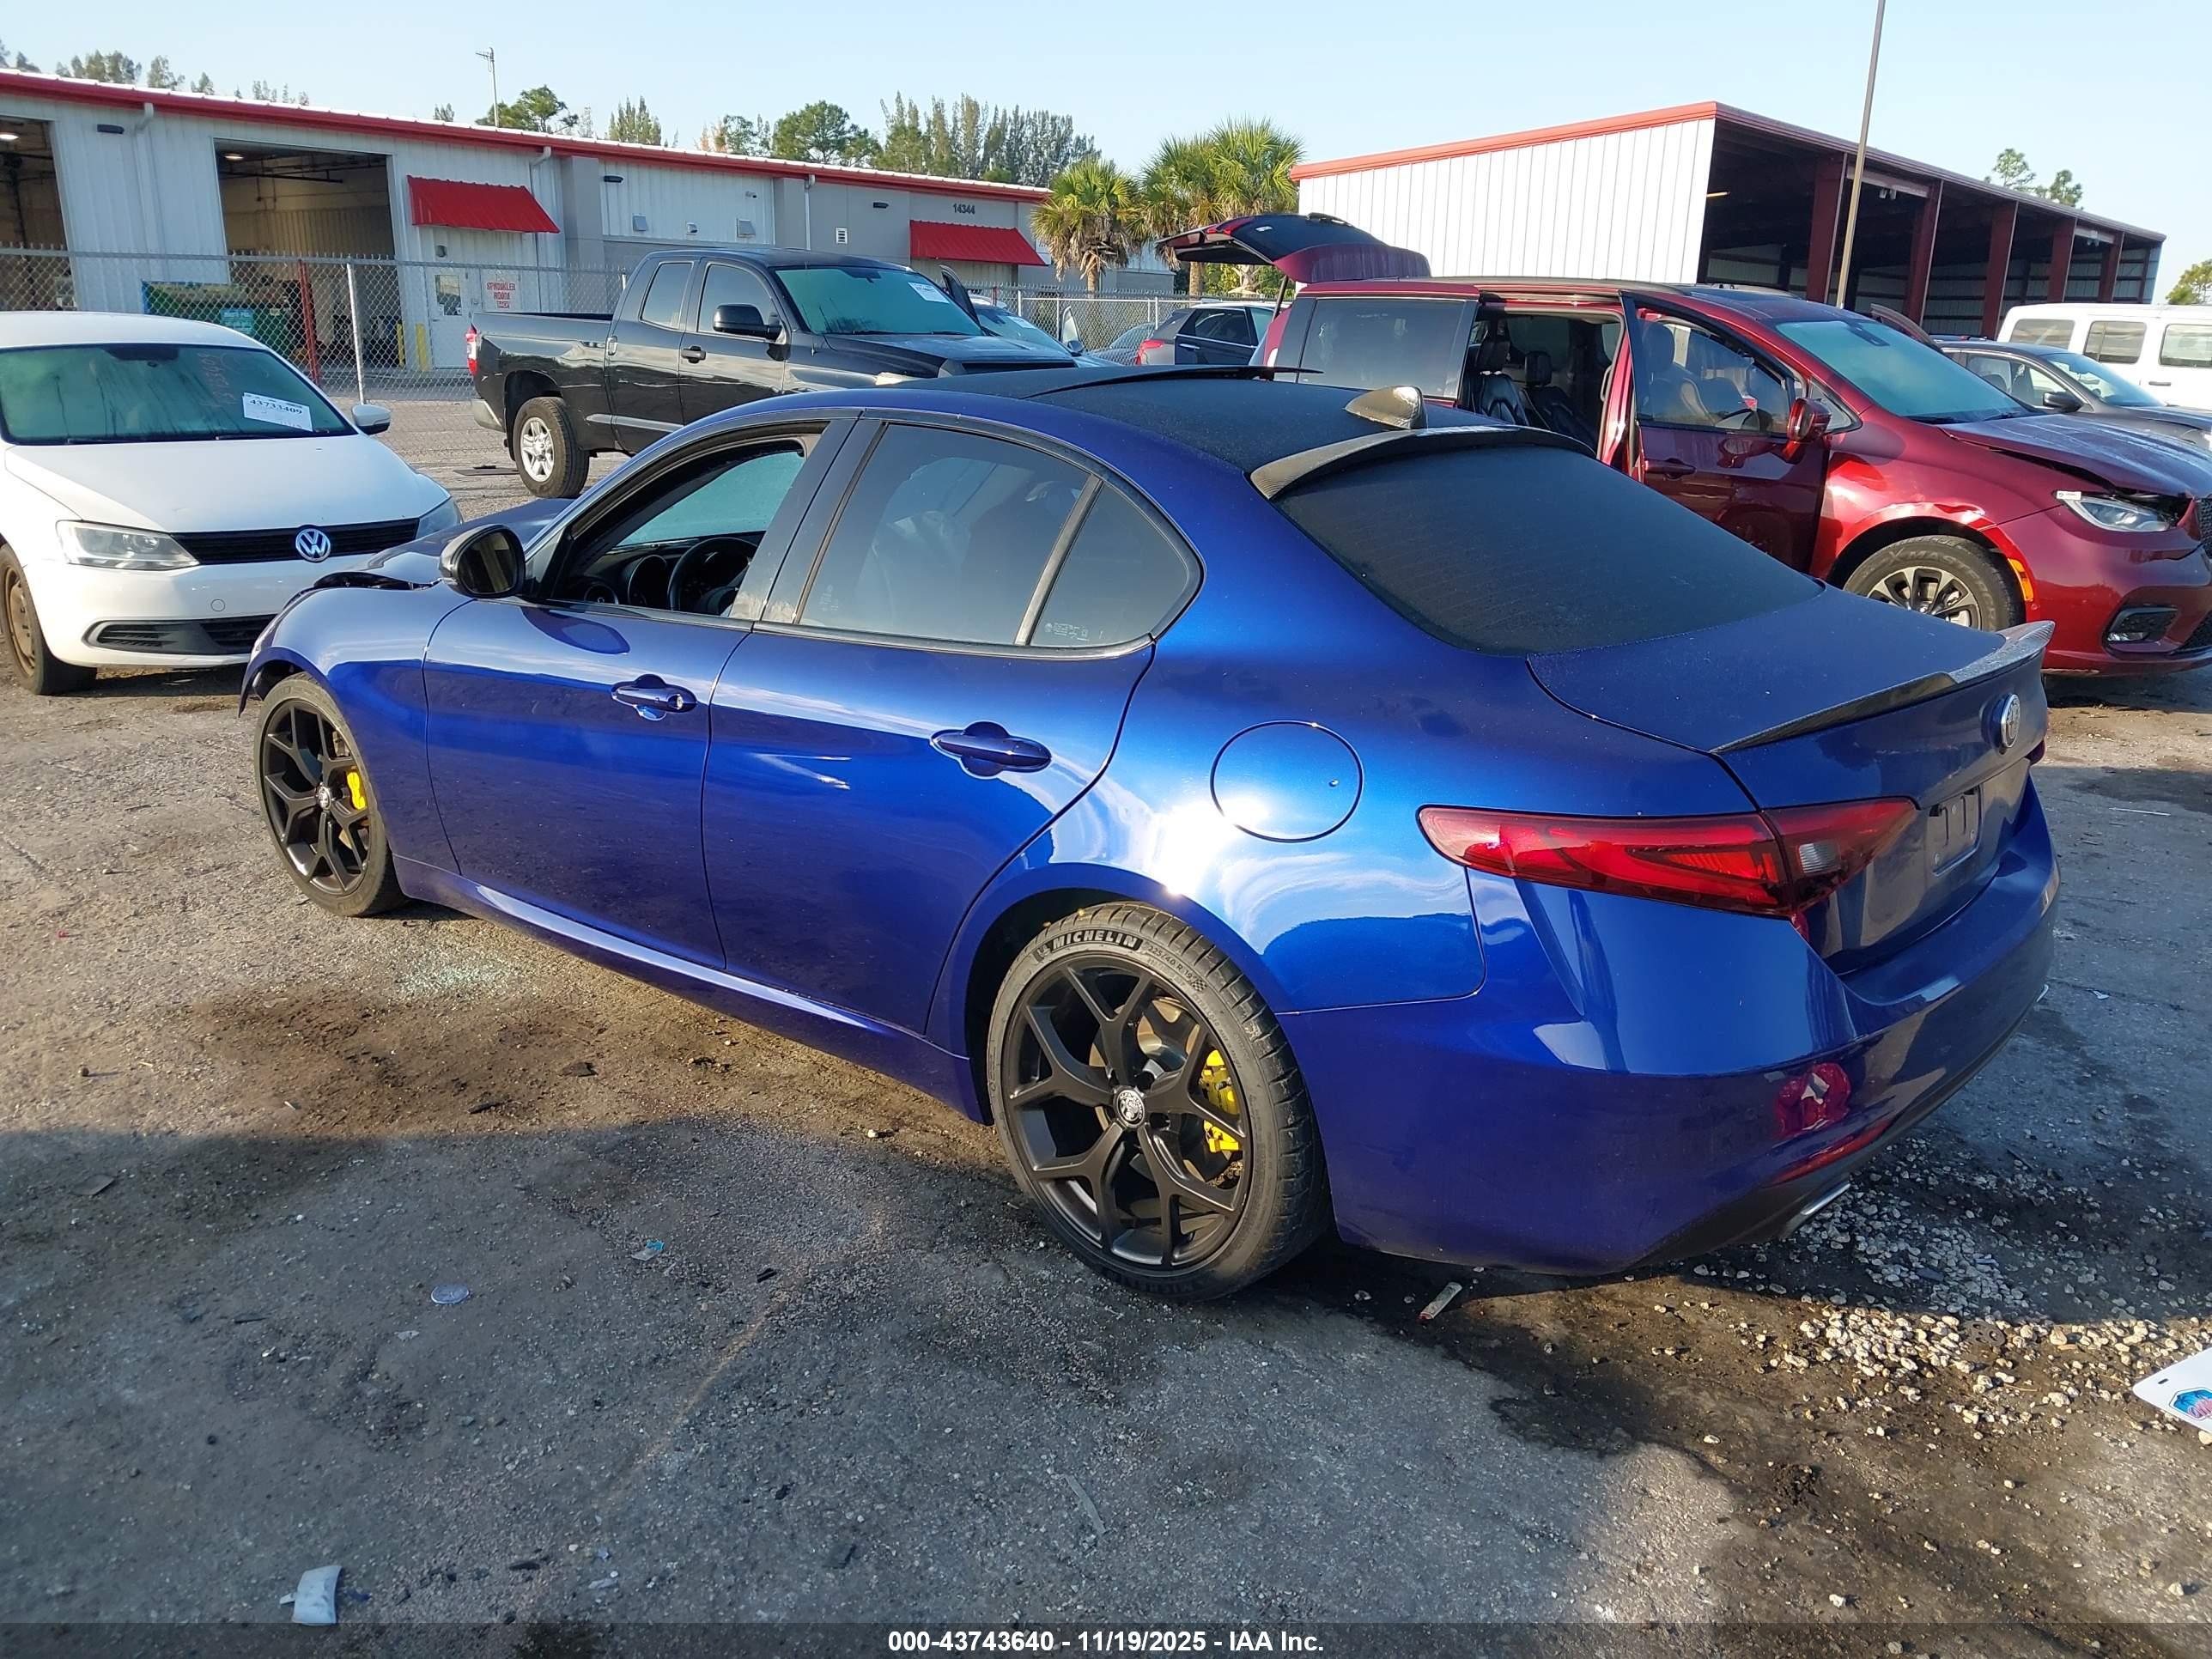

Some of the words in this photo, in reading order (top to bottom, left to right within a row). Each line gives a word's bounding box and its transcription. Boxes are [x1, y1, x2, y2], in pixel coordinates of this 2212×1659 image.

[953, 204, 975, 215] 14344
[250, 399, 303, 415] 43733409
[1053, 930, 1138, 951] MICHELIN
[1147, 945, 1176, 966] 225/40
